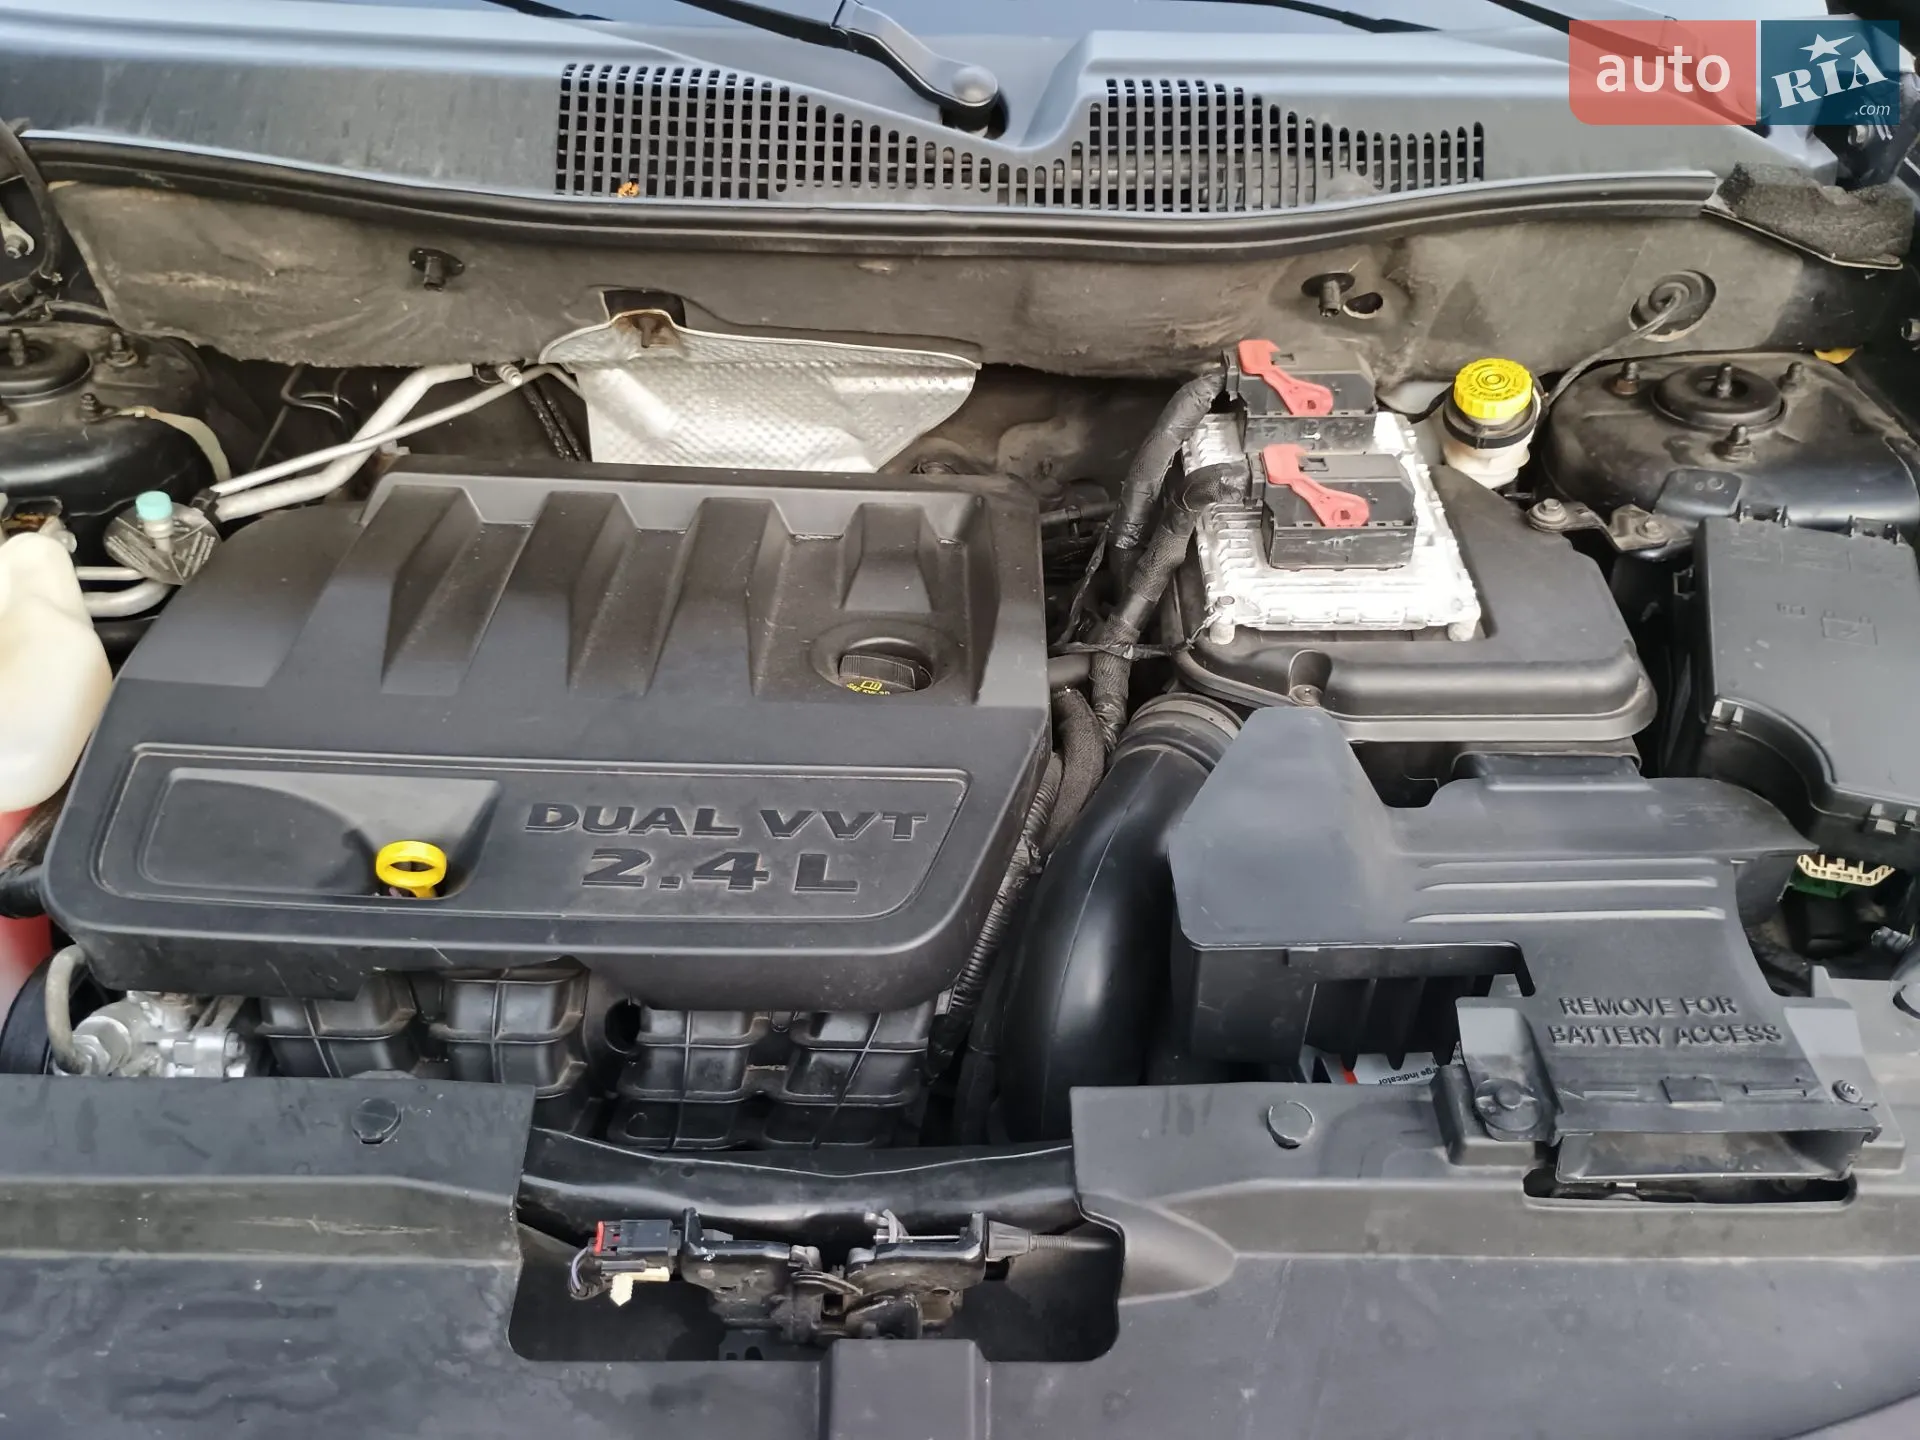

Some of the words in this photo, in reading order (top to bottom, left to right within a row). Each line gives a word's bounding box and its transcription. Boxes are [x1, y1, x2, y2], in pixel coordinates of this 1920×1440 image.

[524, 802, 740, 837] DUAL
[759, 808, 928, 840] VVT
[581, 848, 770, 891] 2.4
[793, 853, 860, 893] L
[1559, 997, 1676, 1017] REMOVE
[1679, 996, 1738, 1015] FOR
[1547, 1024, 1663, 1046] BATTERY
[1674, 1023, 1782, 1044] ACCESS
[1378, 1072, 1419, 1085] indicator
